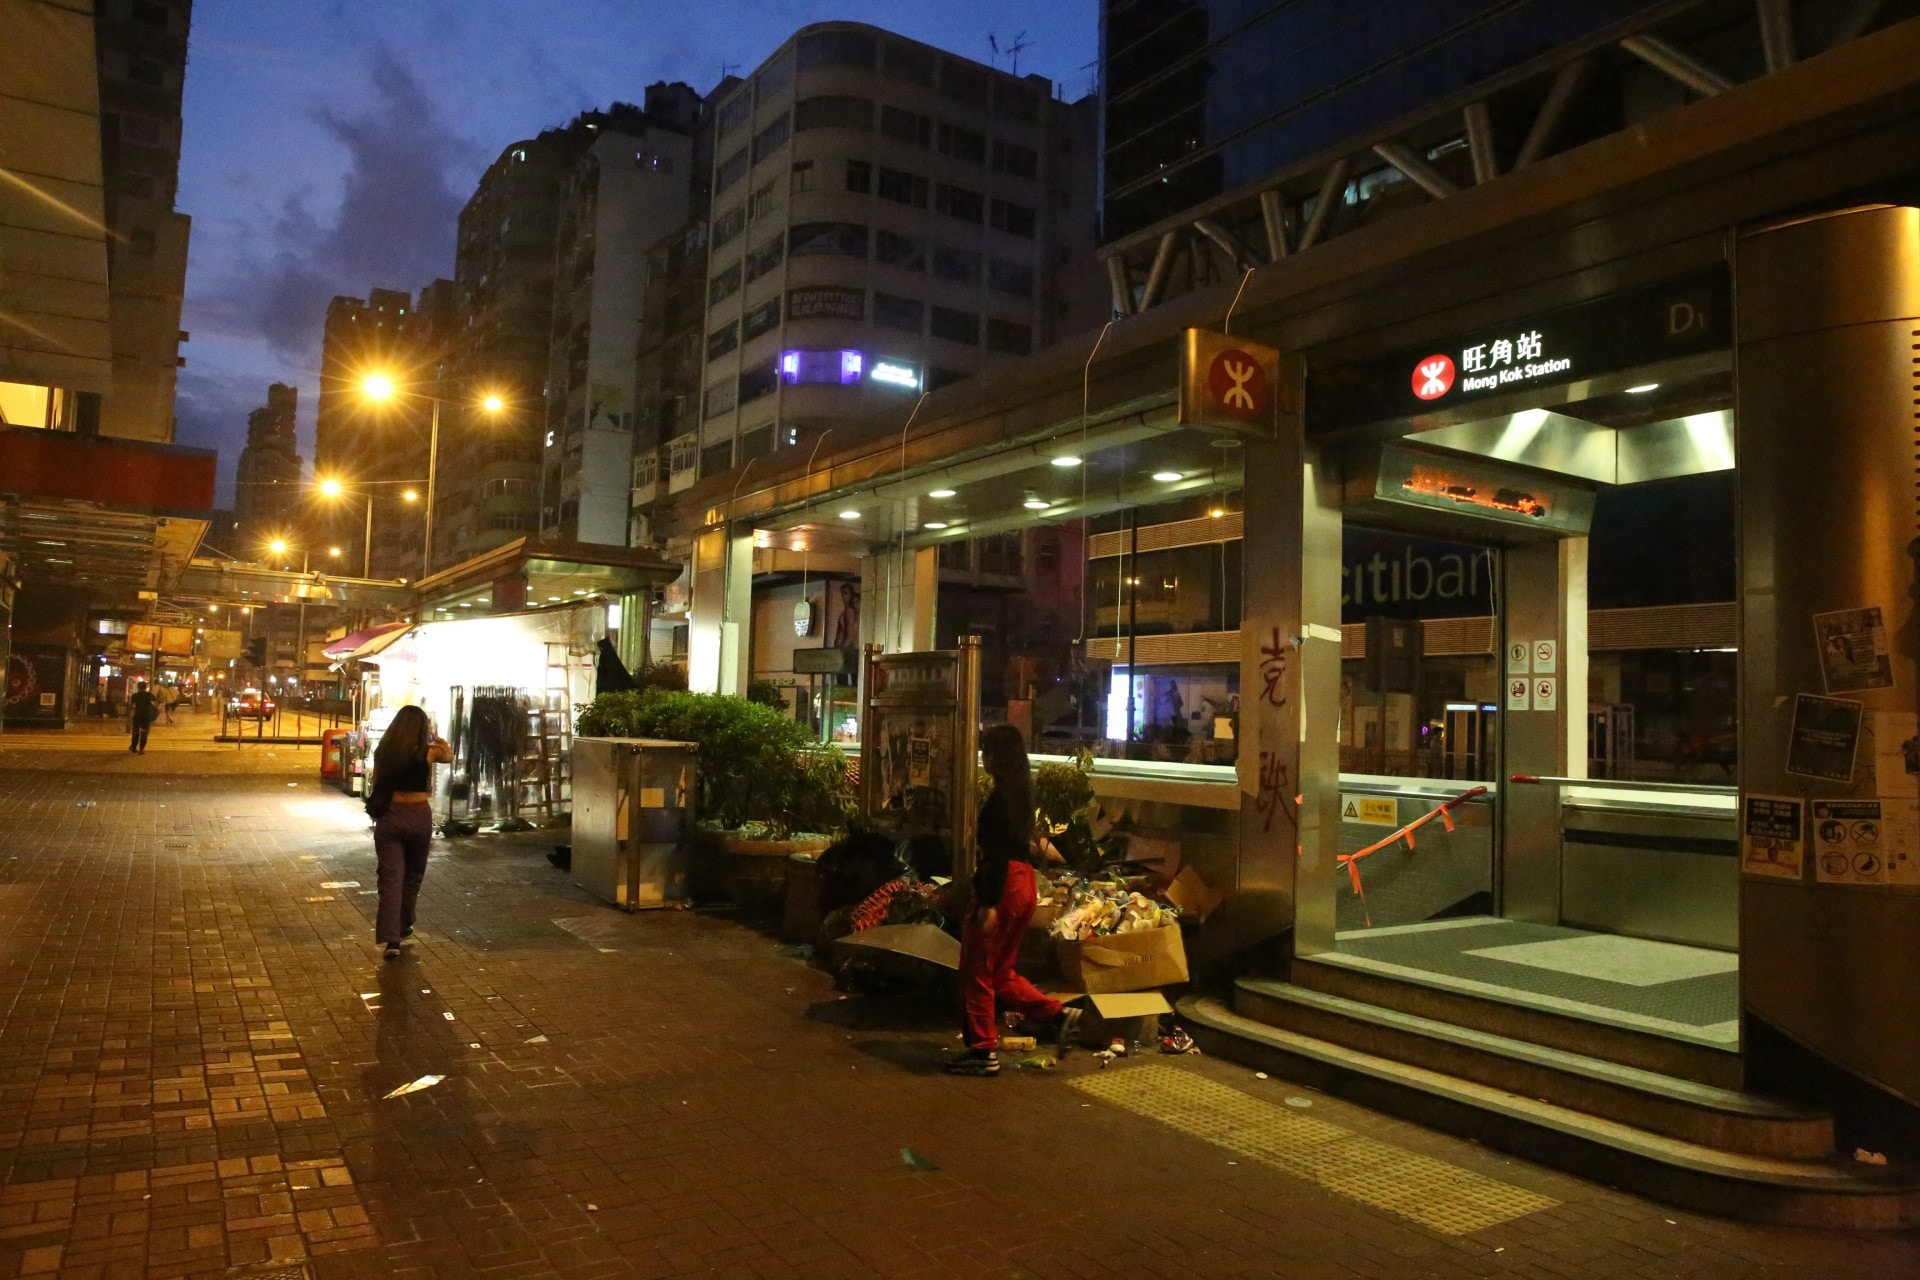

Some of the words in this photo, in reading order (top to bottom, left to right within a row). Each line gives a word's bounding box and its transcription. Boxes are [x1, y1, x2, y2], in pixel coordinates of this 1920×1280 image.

[1669, 302, 1705, 335] D1
[1463, 331, 1543, 372] 旺角站
[1463, 372, 1498, 392] Mong
[1499, 368, 1523, 385] Kok
[1524, 357, 1570, 379] Station
